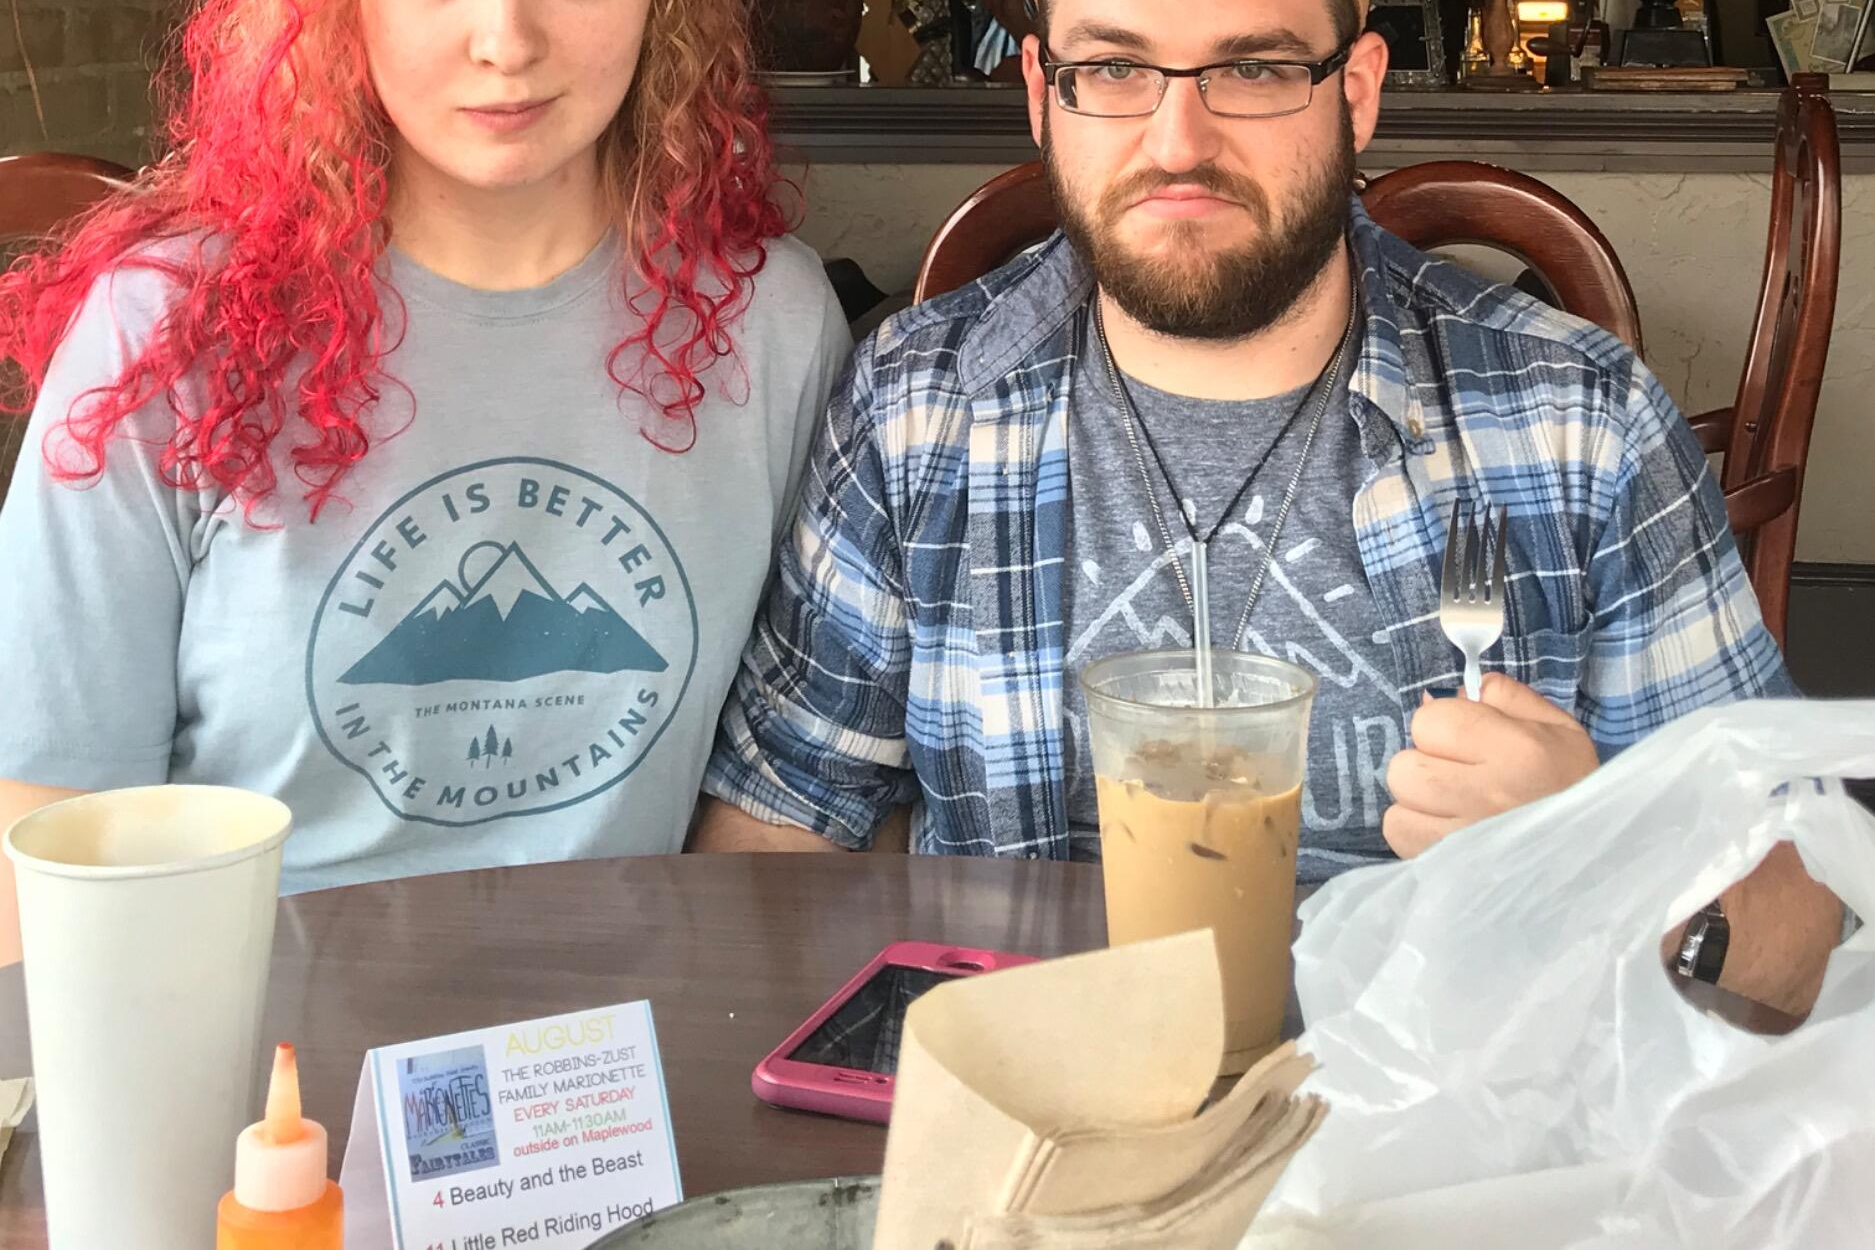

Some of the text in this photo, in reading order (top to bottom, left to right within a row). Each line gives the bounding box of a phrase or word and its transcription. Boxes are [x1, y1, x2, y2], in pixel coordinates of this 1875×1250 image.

[338, 478, 667, 618] LIFE IS BETTER
[415, 694, 586, 718] THE MONTANA SCENE
[335, 688, 659, 808] IN THE MOUNTAINS
[506, 1014, 616, 1057] AUGUST
[498, 1063, 647, 1105] FAMILY MARIONETTE
[501, 1066, 530, 1083] THE
[532, 1045, 637, 1080] ROBBINS-ZUST
[513, 1100, 560, 1123] EVERY
[565, 1086, 636, 1113] SATURDAY
[513, 1118, 653, 1158] outside on Maplewood
[410, 1146, 496, 1175] FAIRYTALES
[432, 1150, 644, 1209] 4 Beauty and the Beast
[452, 1197, 654, 1250] Little Red Riding Hood
